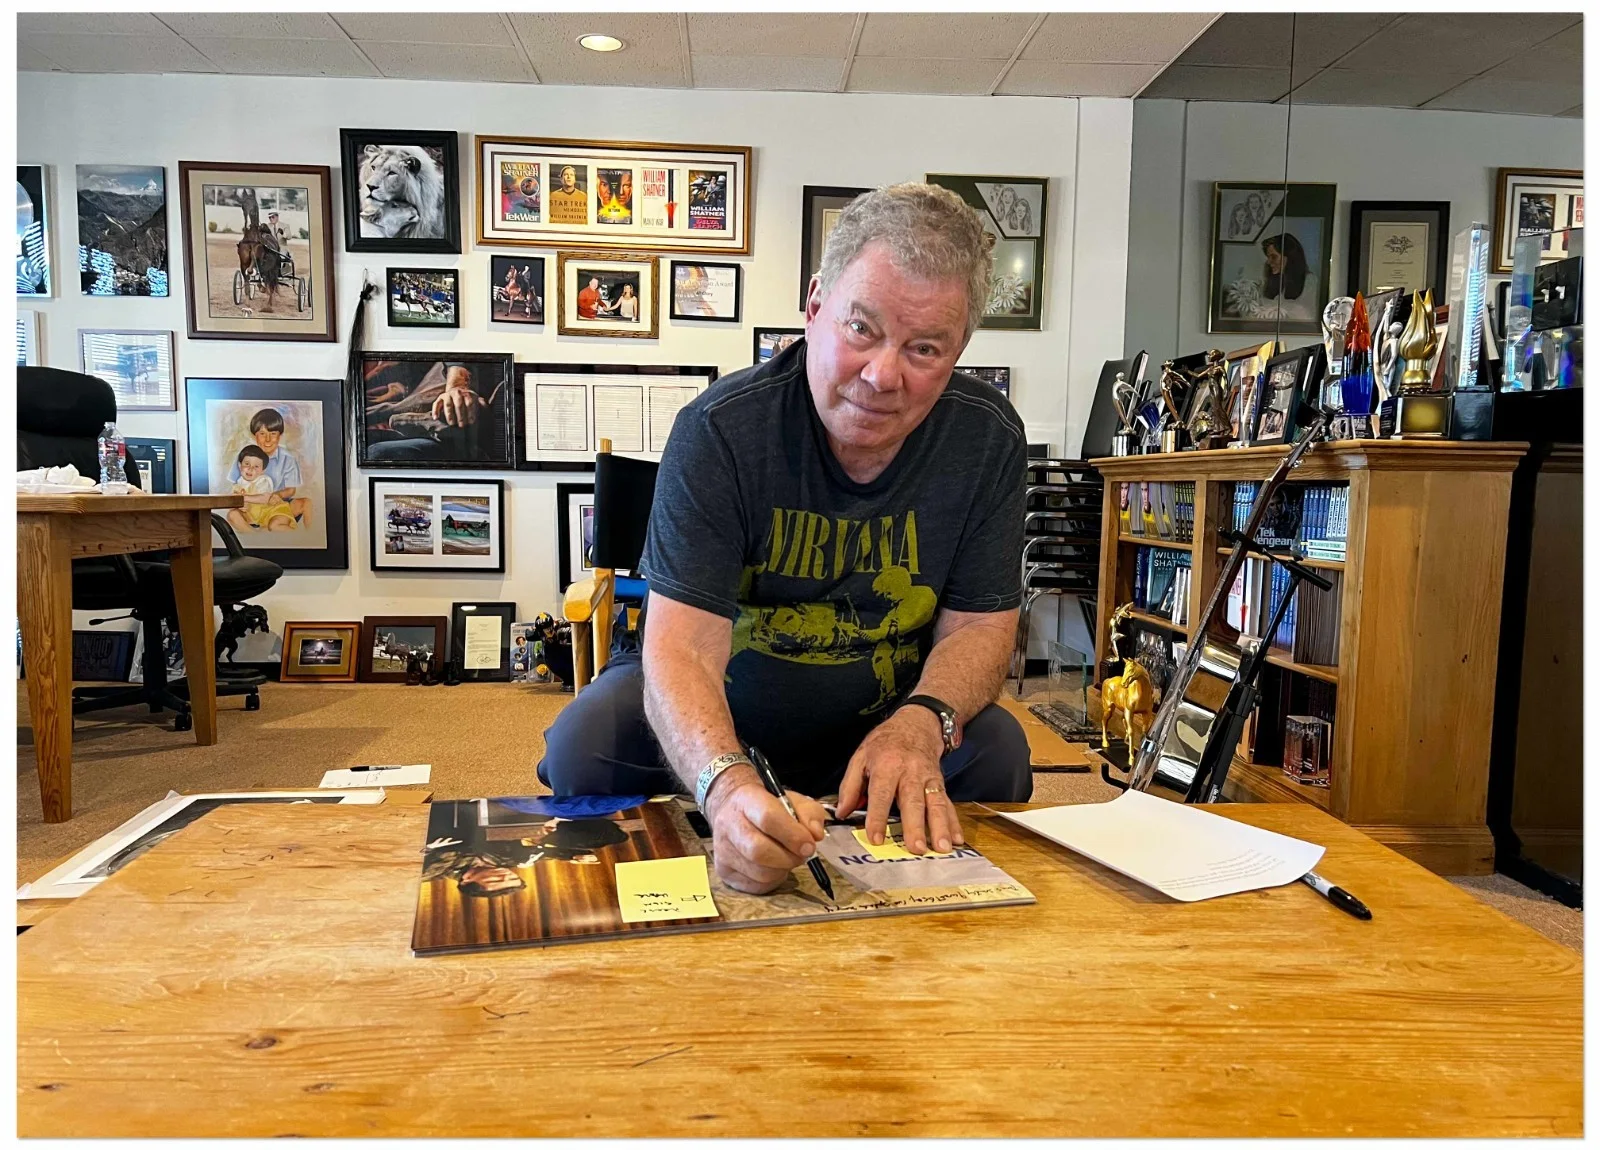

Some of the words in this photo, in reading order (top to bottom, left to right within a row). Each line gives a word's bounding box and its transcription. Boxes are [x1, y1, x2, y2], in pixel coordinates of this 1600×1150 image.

[504, 163, 538, 171] WILLIAM
[643, 170, 665, 183] WILLIAM
[643, 184, 665, 196] SHATNER
[570, 200, 587, 208] TREK
[504, 212, 539, 221] TekWar
[1259, 527, 1275, 537] Tek
[765, 507, 921, 581] NIRVANA
[1256, 534, 1294, 548] engean
[1154, 551, 1186, 560] WILLIA
[1153, 559, 1178, 567] SHAT
